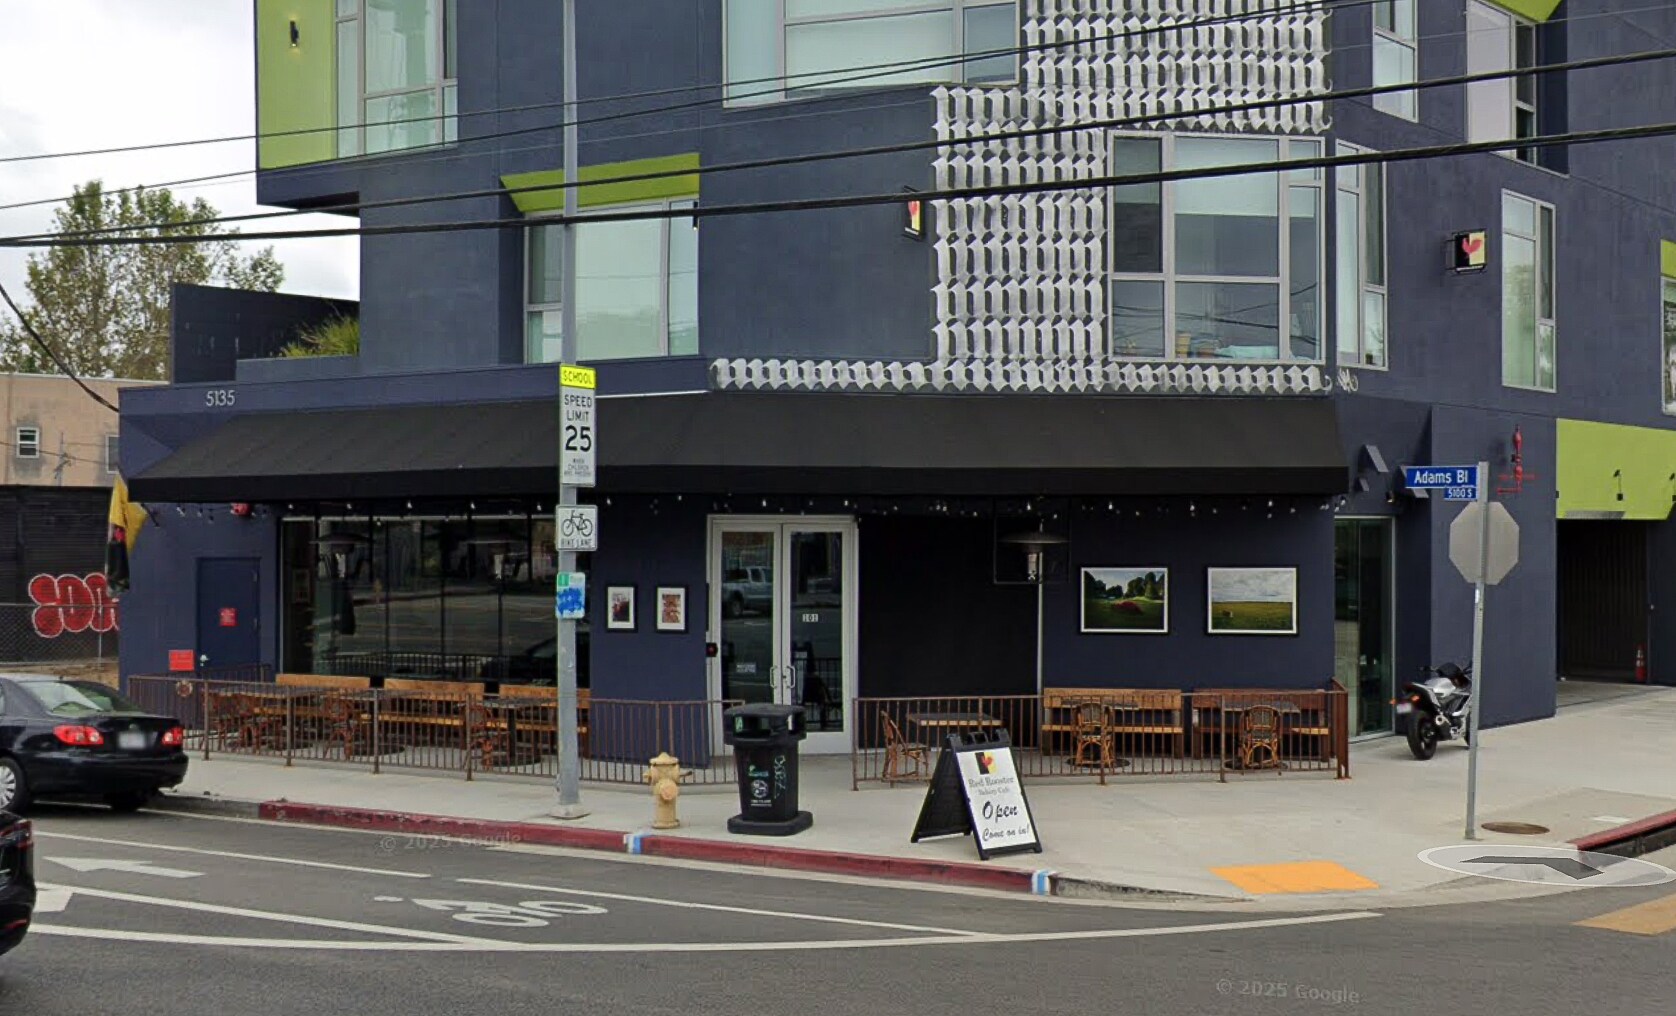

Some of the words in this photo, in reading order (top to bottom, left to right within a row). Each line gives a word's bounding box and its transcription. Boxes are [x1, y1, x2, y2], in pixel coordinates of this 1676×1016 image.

[563, 369, 593, 384] SCHOOL
[206, 389, 236, 407] 5135
[564, 393, 592, 408] SPEED
[566, 409, 589, 422] LIMIT
[565, 425, 592, 452] 25
[1414, 469, 1452, 484] Adams
[1456, 469, 1469, 484] Bl
[1448, 488, 1466, 498] 5100
[1467, 488, 1473, 498] S
[561, 538, 575, 547] BIKE
[577, 538, 593, 548] LANE
[982, 800, 1018, 823] Open
[982, 828, 1005, 842] Come
[1018, 824, 1030, 835] in!
